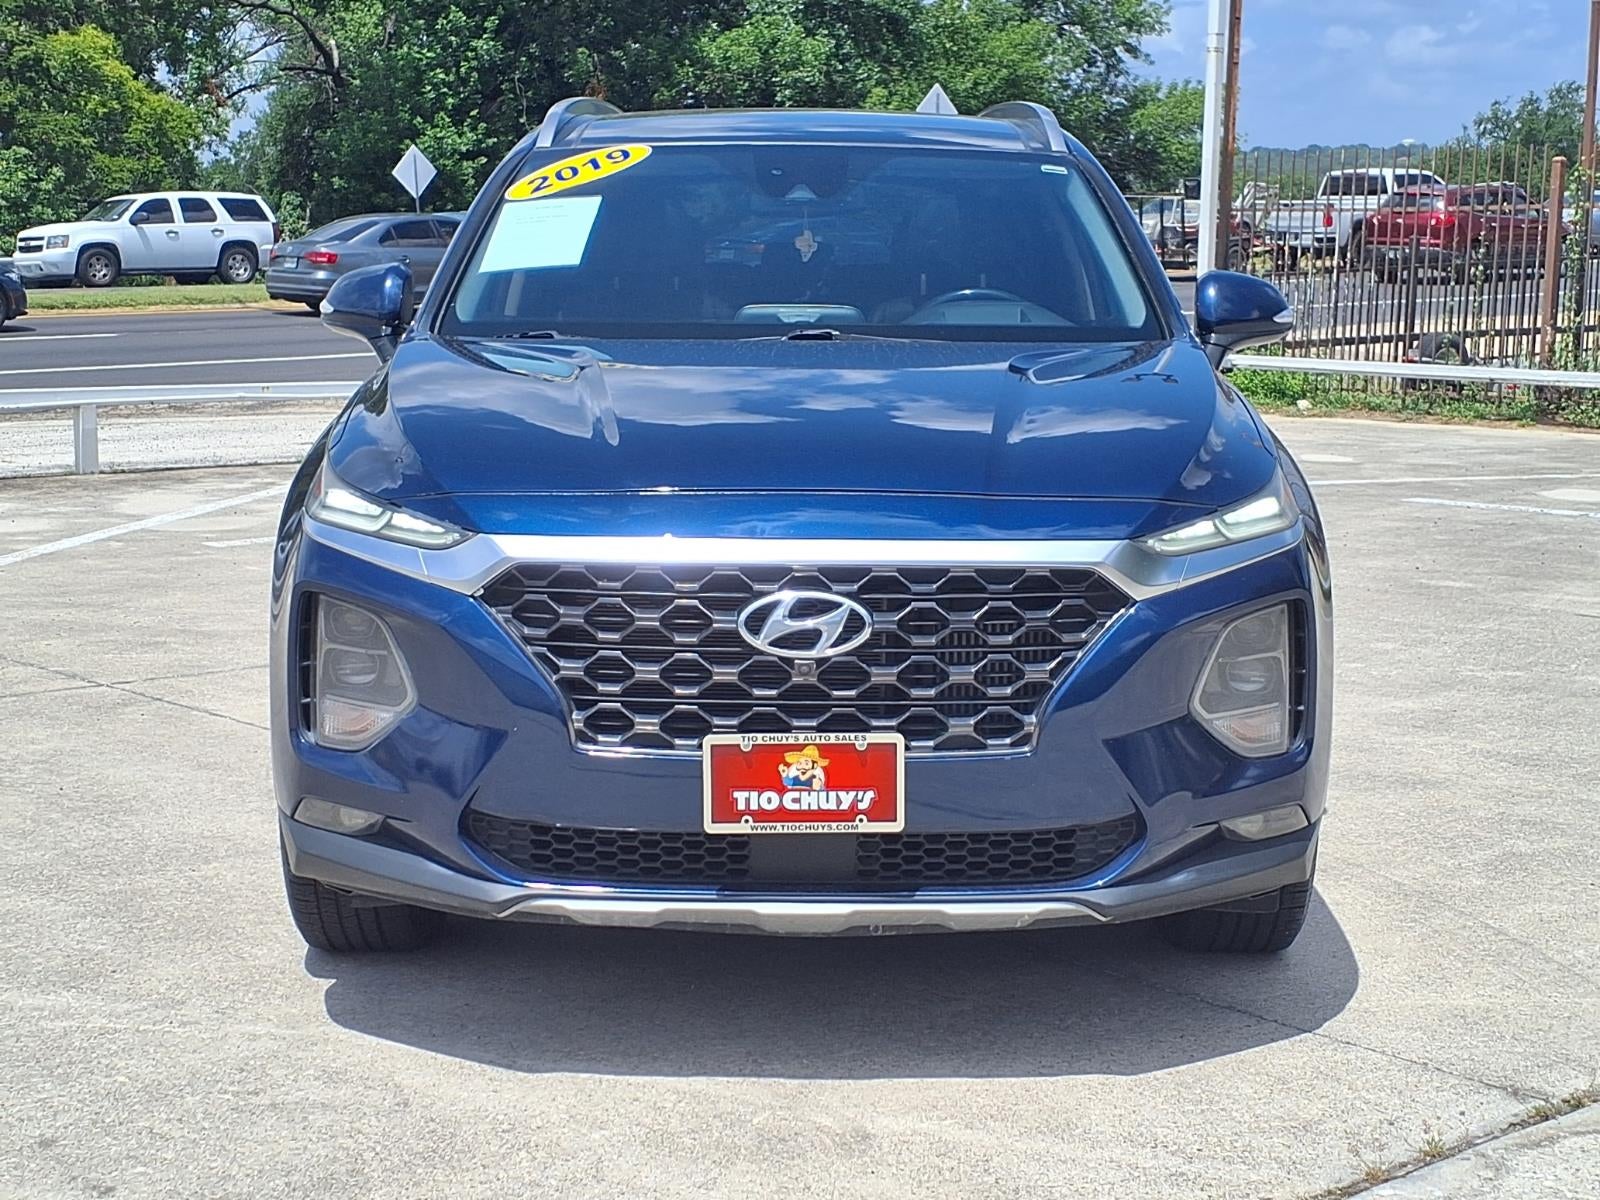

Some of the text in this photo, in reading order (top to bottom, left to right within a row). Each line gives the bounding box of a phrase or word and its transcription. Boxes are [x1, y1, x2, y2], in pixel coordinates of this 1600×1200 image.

[527, 149, 631, 195] 2019
[741, 734, 868, 743] TIO CHUY'S AUTO SALES
[733, 790, 876, 811] TIO CHUY'S
[750, 823, 860, 832] WWW.TIOCHUYS.COM
